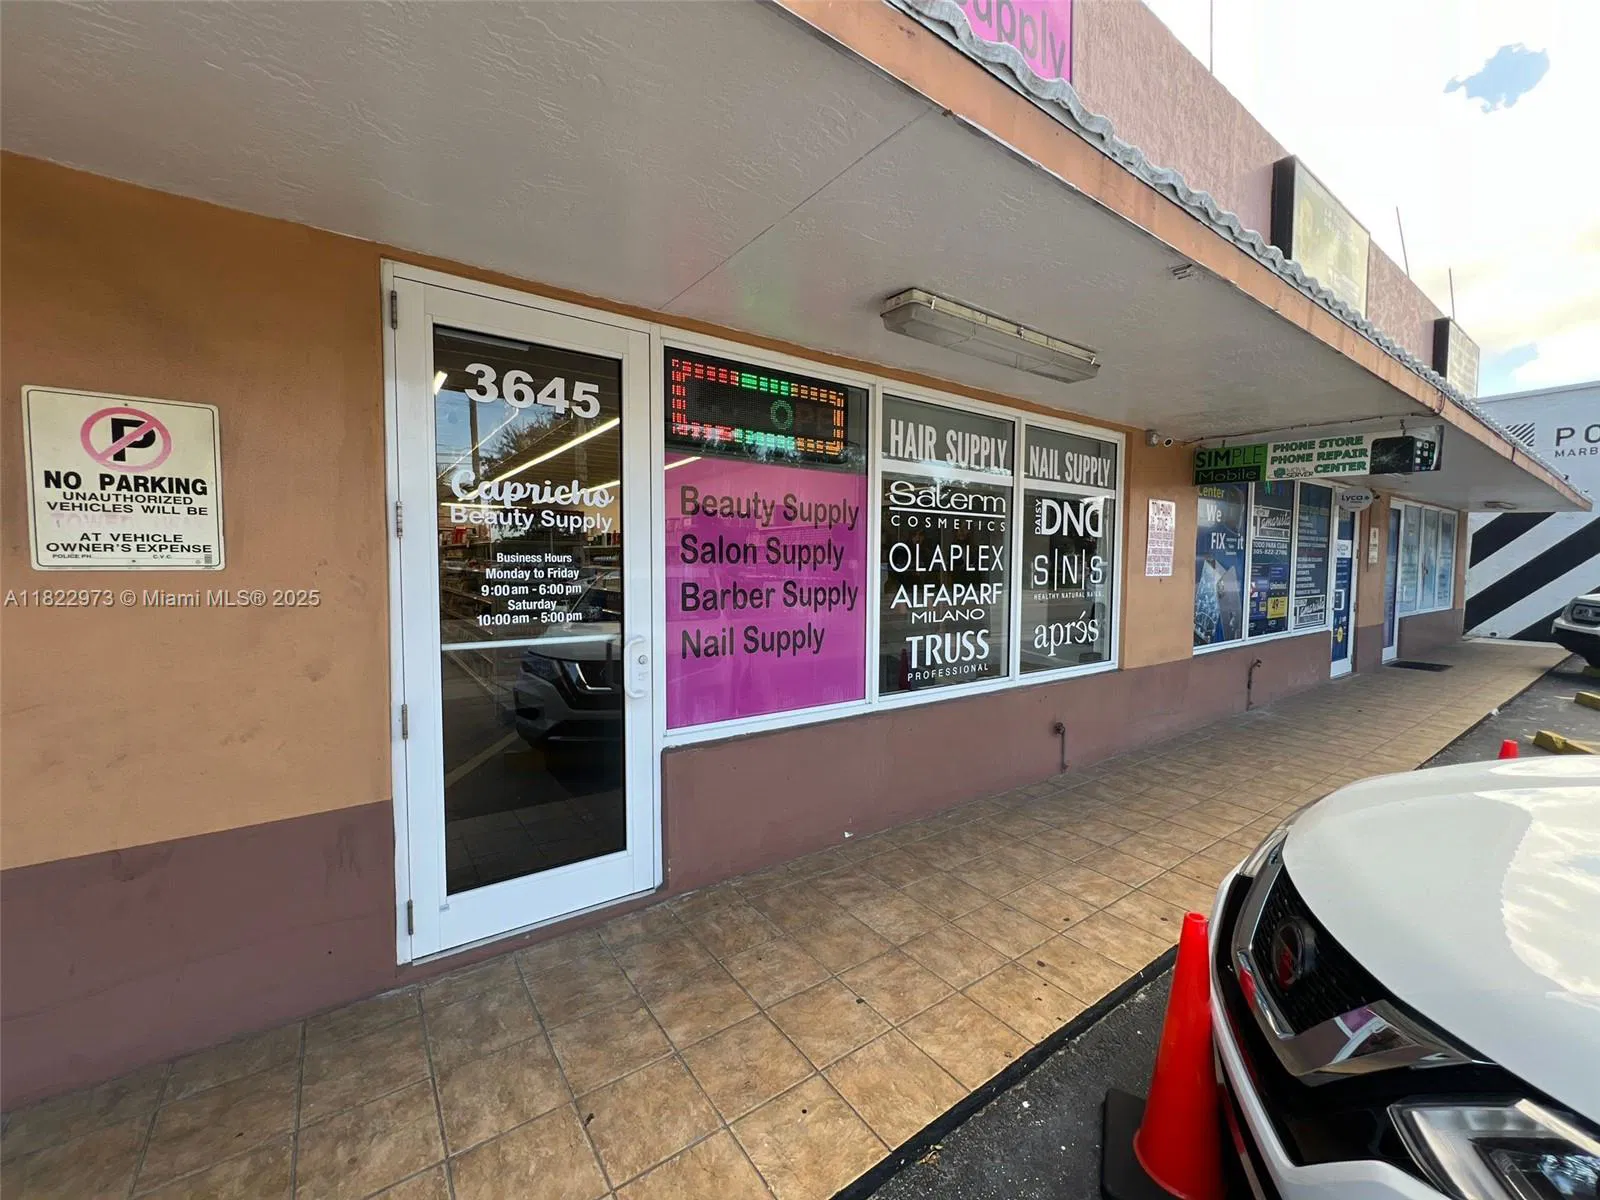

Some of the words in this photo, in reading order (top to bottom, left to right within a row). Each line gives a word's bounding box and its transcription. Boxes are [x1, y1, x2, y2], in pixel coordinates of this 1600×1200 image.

[957, 0, 1066, 78] upply
[464, 362, 600, 419] 3645
[890, 419, 937, 462] HAIR
[946, 429, 1008, 472] SUPPLY
[1273, 440, 1315, 453] PHONE
[1319, 436, 1364, 449] STORE
[1195, 446, 1264, 468] SIMPLE
[1271, 452, 1314, 465] PHONE
[1317, 448, 1368, 461] REPAIR
[1029, 445, 1061, 480] NAIL
[1065, 451, 1111, 487] SUPPLY
[1314, 461, 1367, 474] CENTER
[44, 470, 82, 490] NO
[99, 473, 208, 496] PARKING
[1199, 469, 1257, 482] Mobile
[62, 491, 193, 505] UNAUTHORIZED
[451, 469, 614, 509] Capricho
[46, 502, 134, 514] VEHICLES
[142, 504, 180, 515] WILL
[187, 506, 208, 516] BE
[680, 485, 775, 527] Beauty
[783, 493, 859, 531] Supply
[1206, 504, 1222, 522] We
[450, 506, 535, 531] Beauty
[541, 509, 613, 533] Supply
[891, 515, 1006, 532] COSMETICS
[80, 533, 103, 542] AT
[110, 533, 183, 543] VEHICLE
[1211, 532, 1226, 550] FIX
[1237, 532, 1244, 550] it
[46, 543, 131, 553] OWNER'S
[136, 544, 212, 554] EXPENSE
[680, 534, 757, 565] Salon
[766, 537, 844, 571] Supply
[889, 542, 1004, 573] OLAPLEX
[496, 553, 542, 563] Business
[544, 553, 572, 563] Hours
[485, 568, 530, 581] Monday
[533, 569, 544, 579] to
[547, 568, 580, 581] Friday
[508, 599, 557, 611] Saturday
[682, 581, 775, 612] Barber
[783, 580, 858, 613] Supply
[890, 583, 1003, 609] ALFAPARF
[911, 608, 985, 624] MILANO
[682, 626, 734, 659] Nail
[743, 622, 825, 658] Supply
[906, 629, 990, 669] TRUSS
[908, 663, 989, 681] PROFESSIONAL
